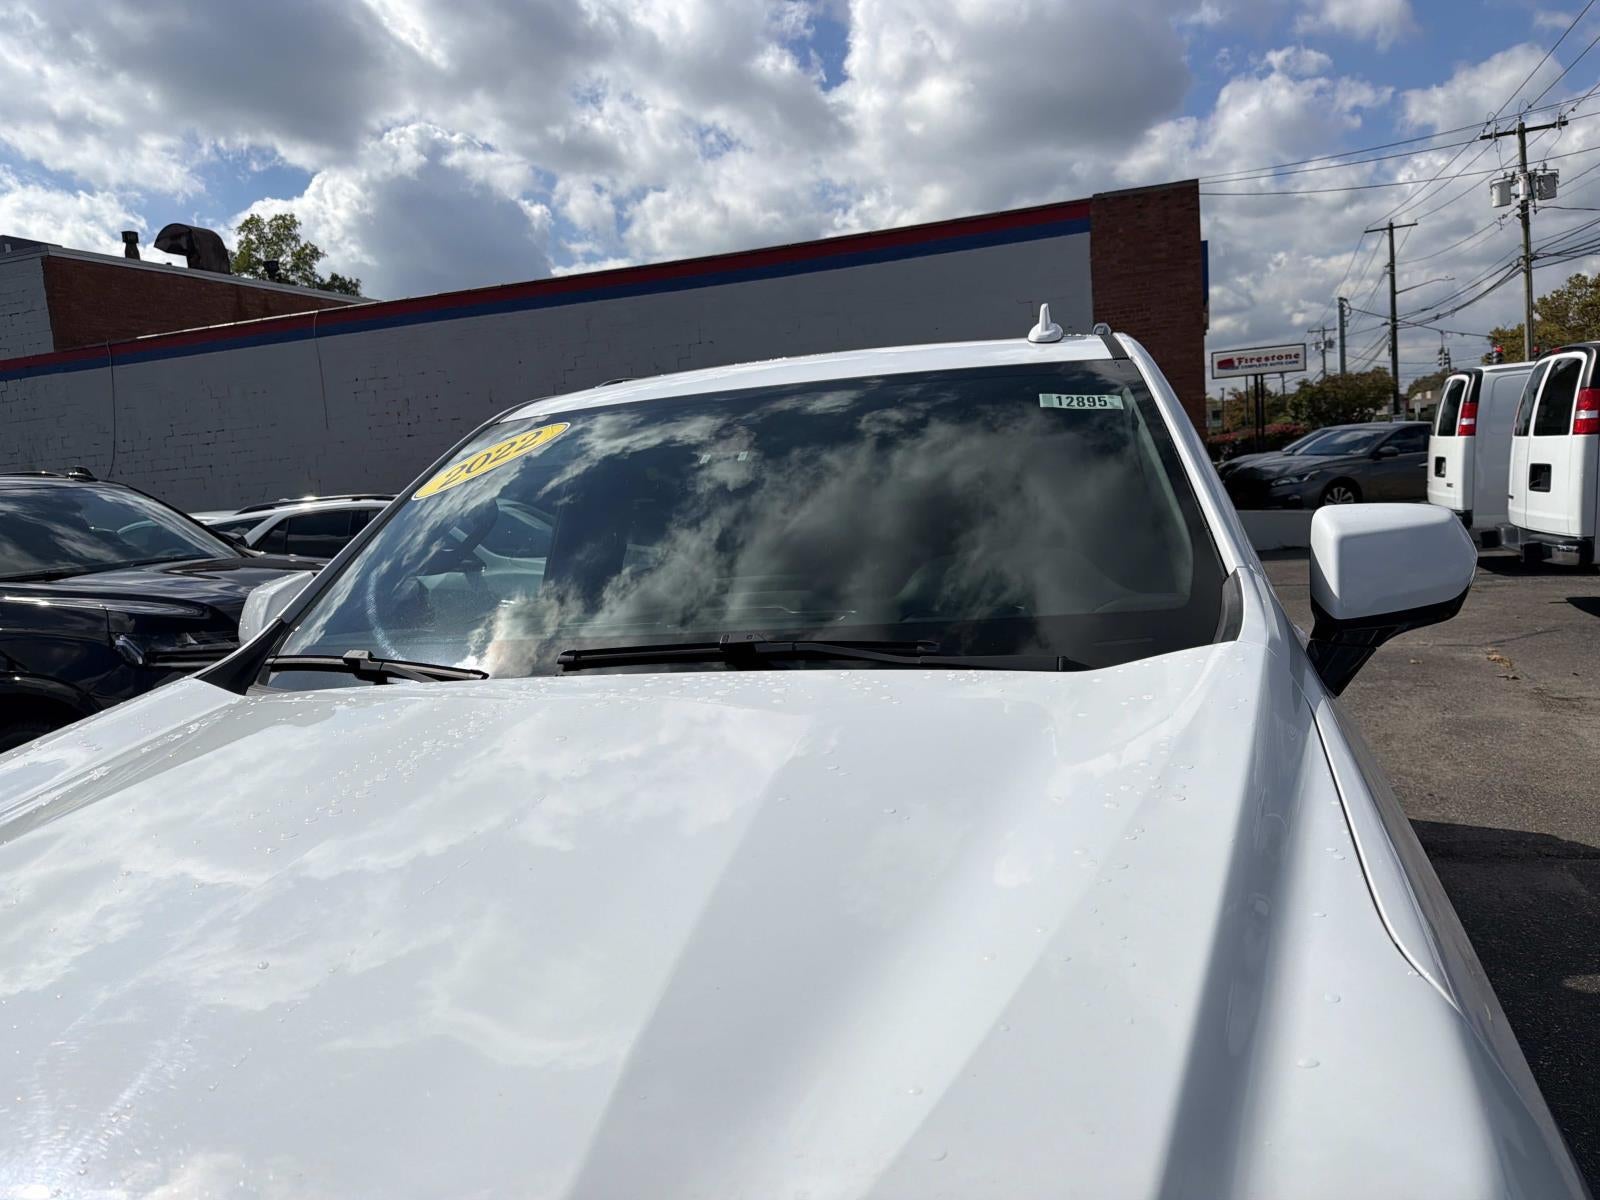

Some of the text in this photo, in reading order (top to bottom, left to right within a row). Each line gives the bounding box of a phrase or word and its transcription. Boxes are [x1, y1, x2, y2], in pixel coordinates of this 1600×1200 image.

[1236, 352, 1301, 365] Firestone
[1055, 395, 1108, 408] 12895
[437, 430, 544, 490] 2022
